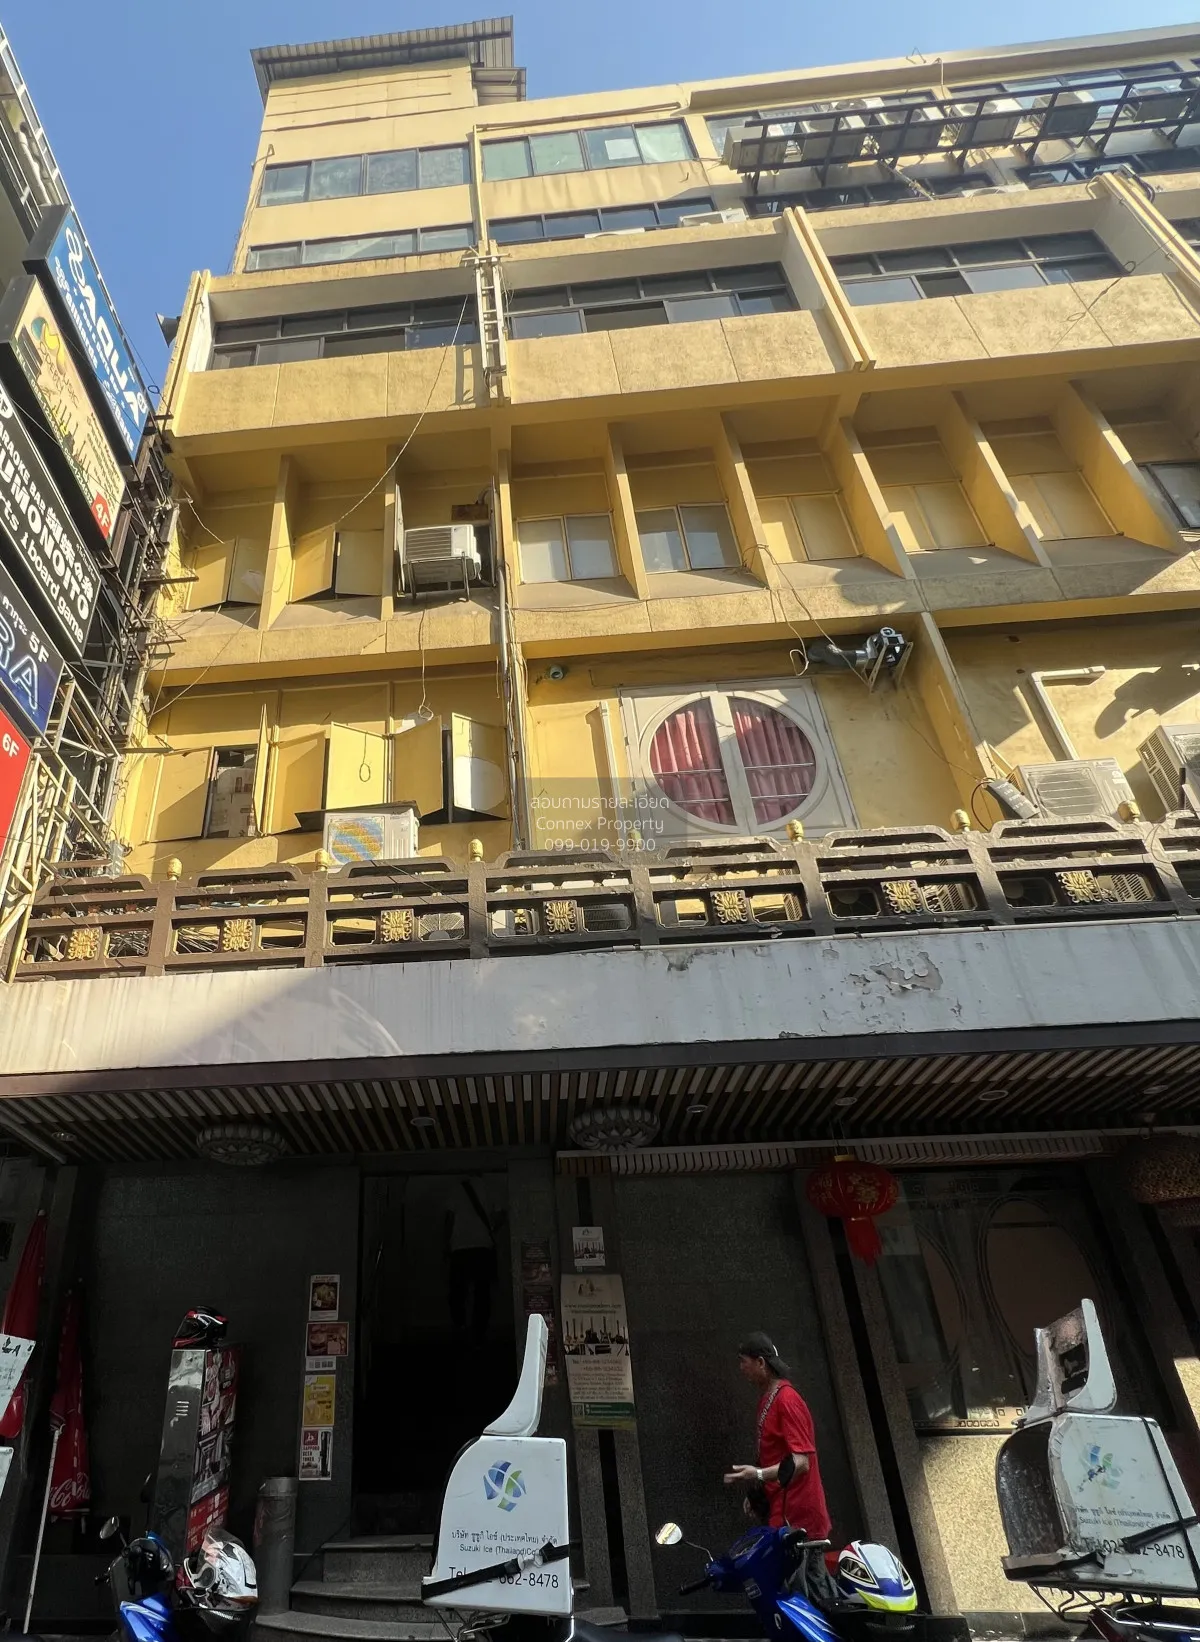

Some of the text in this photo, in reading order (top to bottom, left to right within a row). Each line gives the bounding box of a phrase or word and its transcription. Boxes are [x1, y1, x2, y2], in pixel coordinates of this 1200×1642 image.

[80, 302, 93, 332] Pool
[95, 341, 111, 375] Darts
[109, 373, 120, 396] Bar
[66, 288, 98, 369] Billiards
[114, 405, 135, 451] Darts
[29, 481, 46, 516] BAR
[95, 503, 110, 531] 4F
[27, 539, 61, 601] board
[57, 595, 84, 644] game
[29, 631, 49, 663] 5F
[2, 733, 20, 758] 6F
[1079, 1517, 1101, 1525] Suzuki
[460, 1544, 481, 1552] Suzuki
[483, 1545, 492, 1553] Ice
